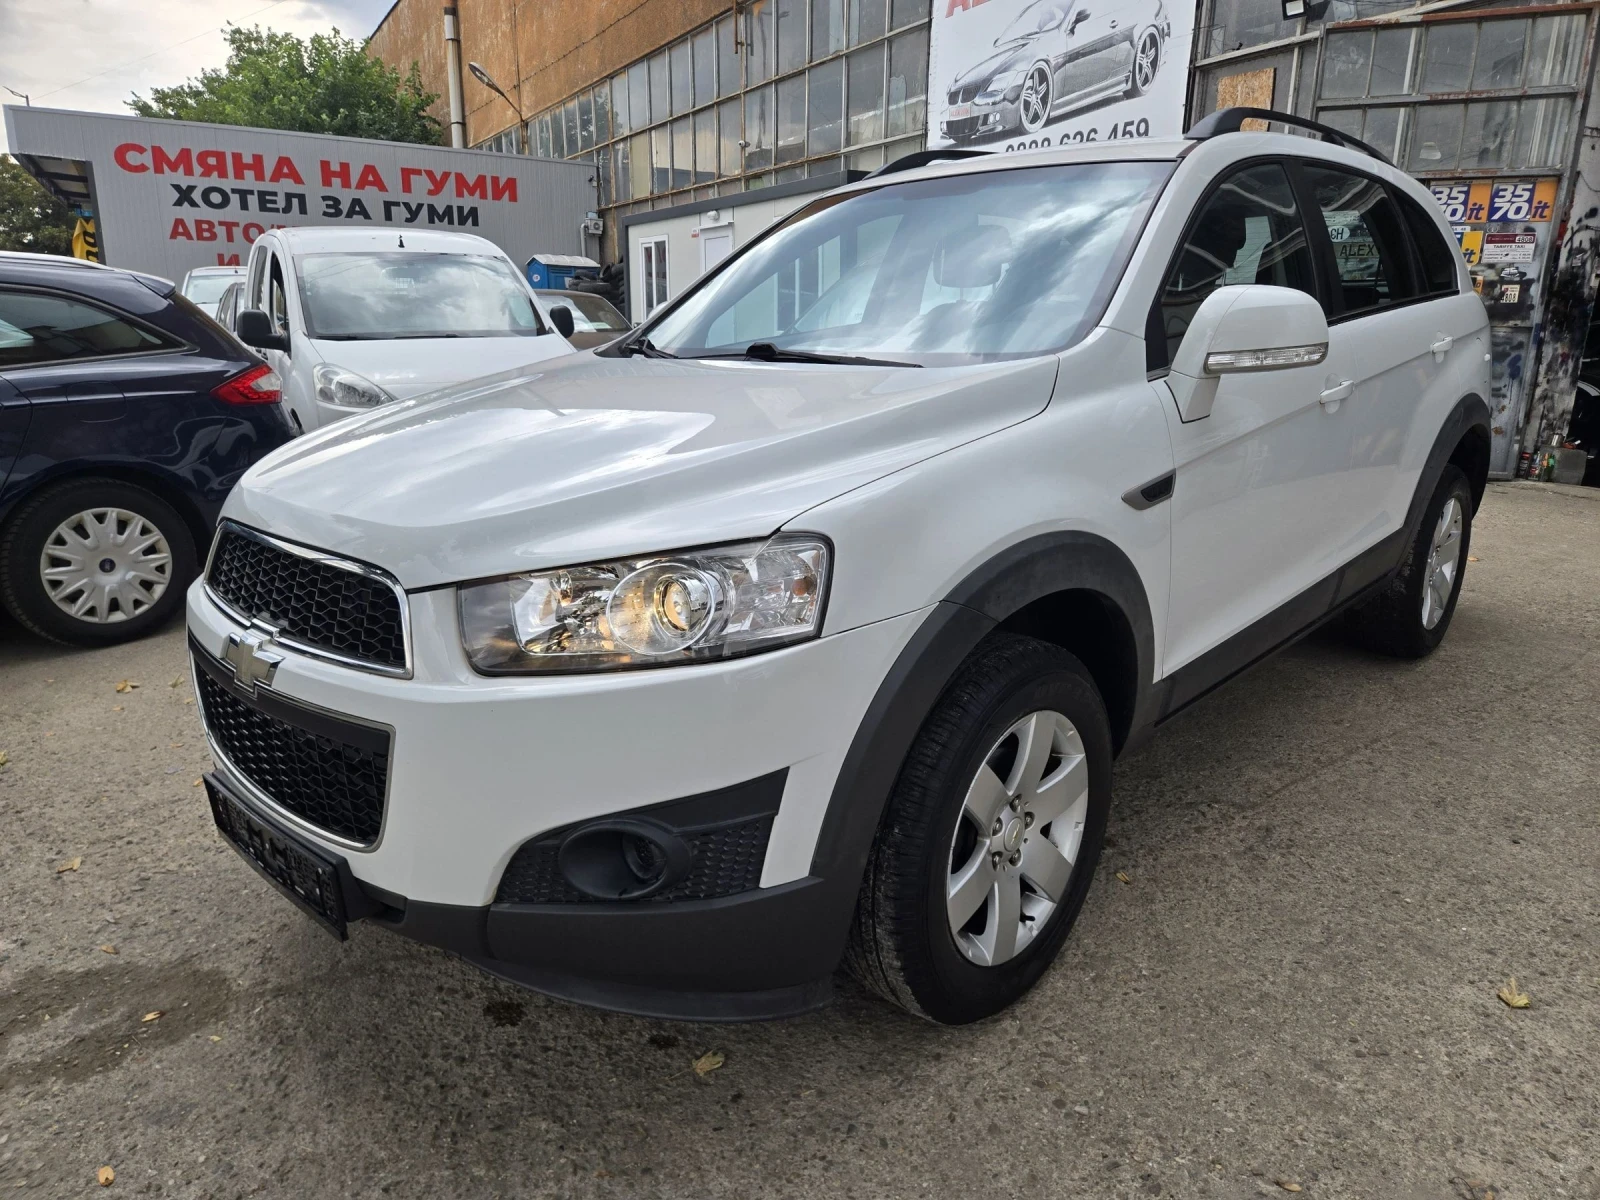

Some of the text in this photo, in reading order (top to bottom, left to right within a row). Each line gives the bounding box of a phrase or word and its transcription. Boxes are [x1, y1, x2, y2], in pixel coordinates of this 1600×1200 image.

[114, 142, 518, 203] СМЯНА НА ГУМИ
[170, 183, 480, 227] ХОТЕЛ ЗА ГУМИ
[1494, 184, 1533, 203] 35
[1340, 243, 1375, 256] ALEX
